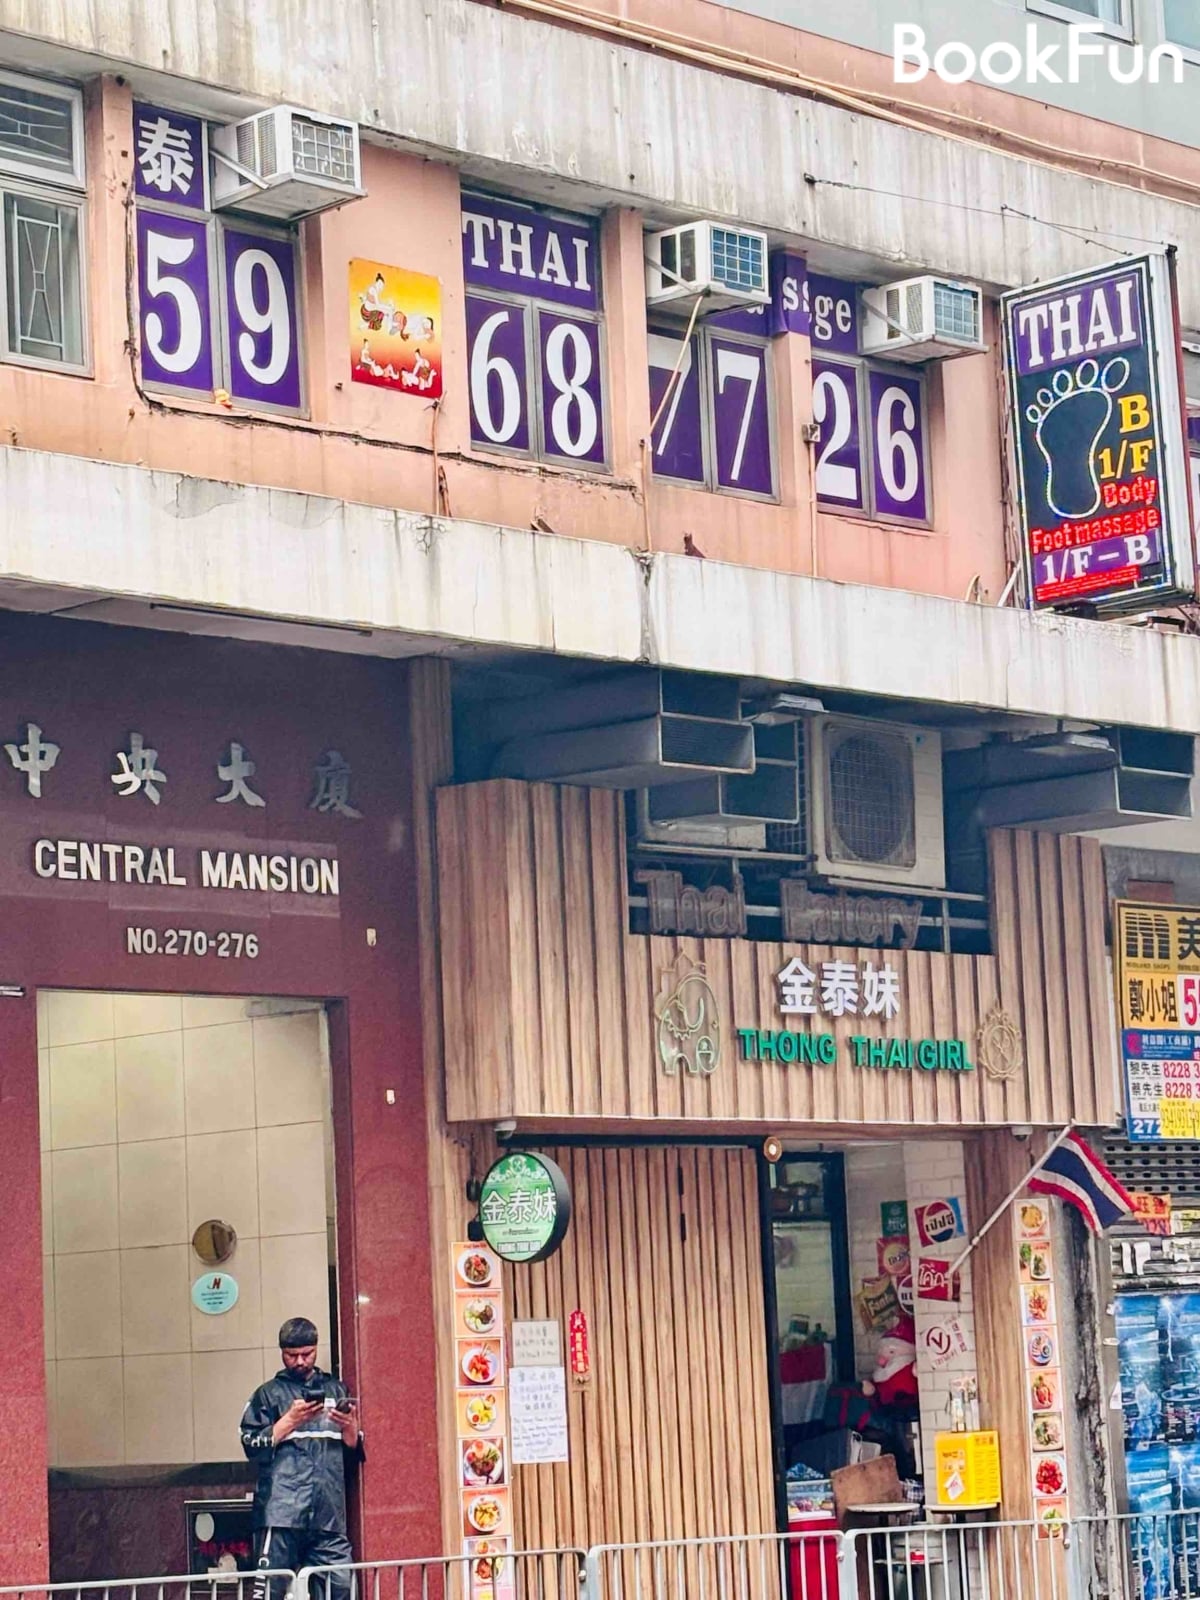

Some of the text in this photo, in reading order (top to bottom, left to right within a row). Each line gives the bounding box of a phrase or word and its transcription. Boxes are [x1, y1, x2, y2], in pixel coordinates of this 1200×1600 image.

[137, 116, 195, 196] 泰
[461, 211, 592, 292] THAI
[1018, 279, 1137, 368] THAI
[1118, 393, 1151, 434] B
[1099, 439, 1154, 479] 1/F
[1103, 475, 1157, 509] Body
[34, 838, 340, 896] CENTRAL MANSION
[126, 926, 260, 959] NO.270-276
[777, 956, 901, 1020] 金泰妹
[737, 1028, 975, 1072] THONG THAI GIRL
[1163, 1061, 1191, 1079] 8228
[1165, 1081, 1192, 1099] 8228
[481, 1186, 558, 1225] 金泰妹
